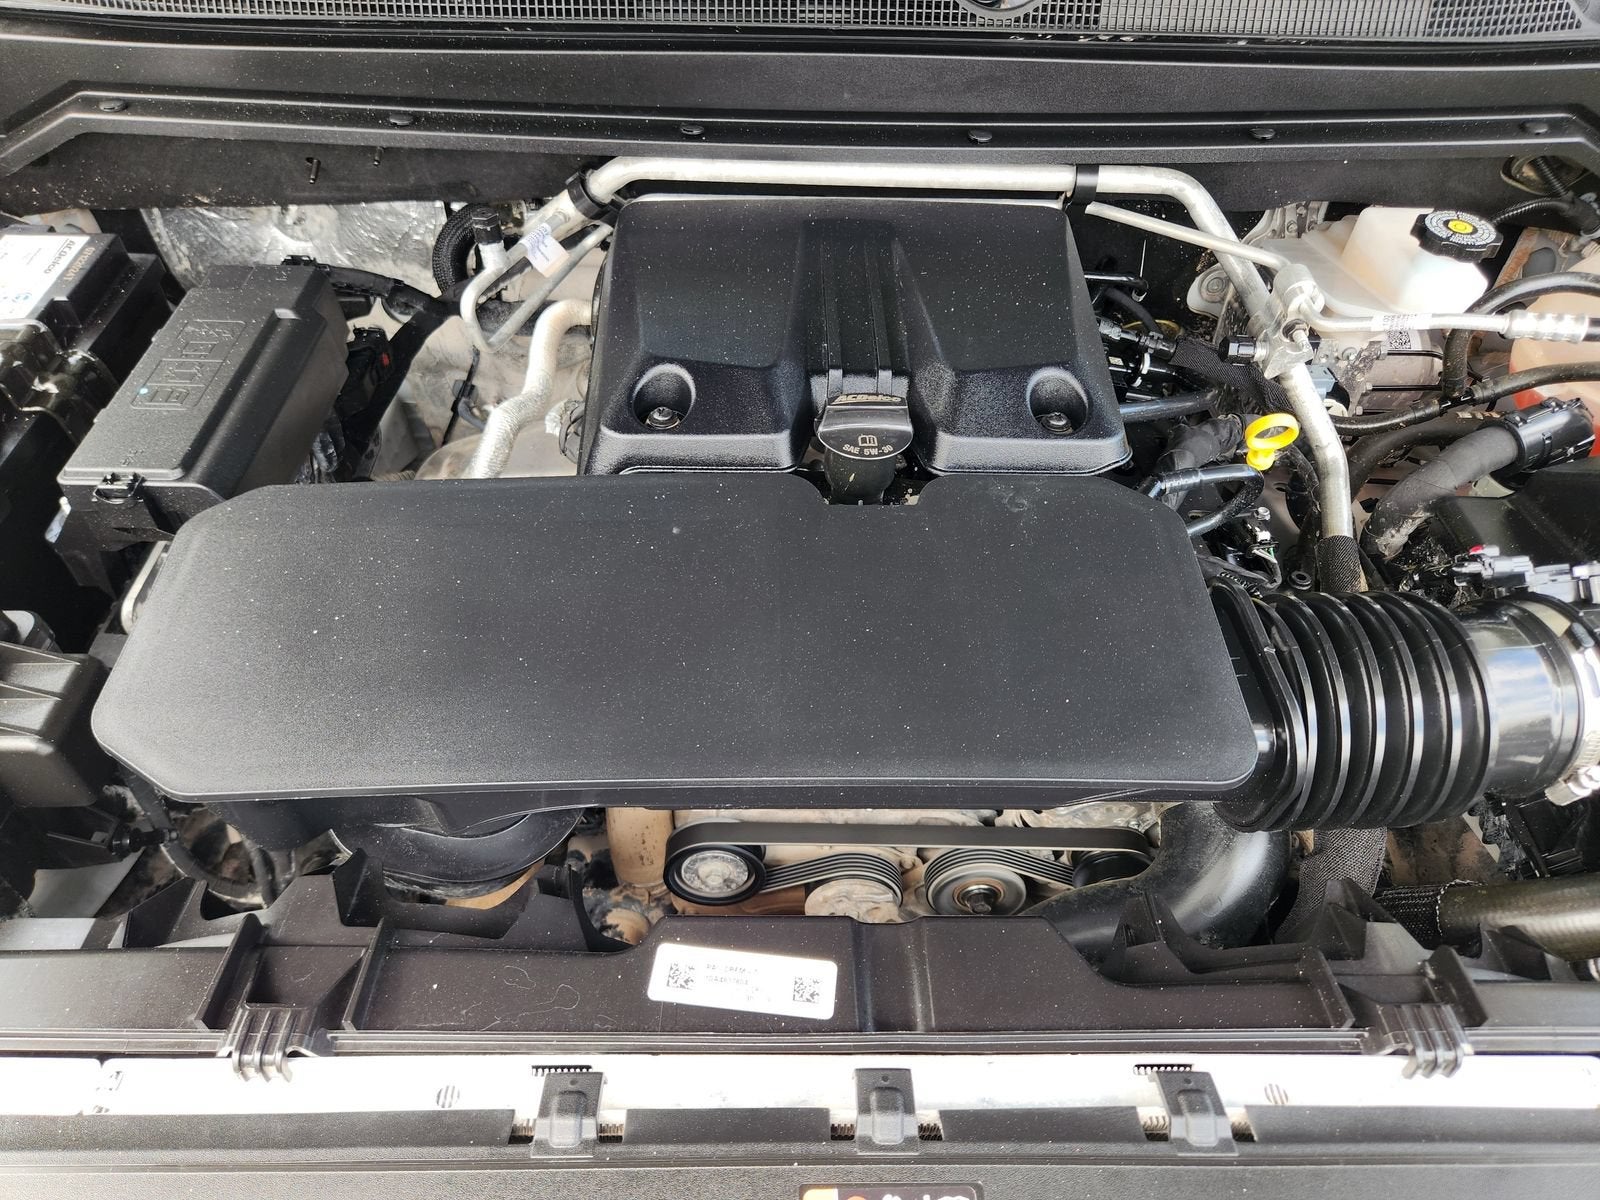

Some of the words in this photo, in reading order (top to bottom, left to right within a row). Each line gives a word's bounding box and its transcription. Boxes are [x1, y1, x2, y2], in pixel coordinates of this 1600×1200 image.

[832, 394, 901, 404] ACDelco
[842, 443, 860, 454] SAE
[863, 445, 893, 455] 5W-30
